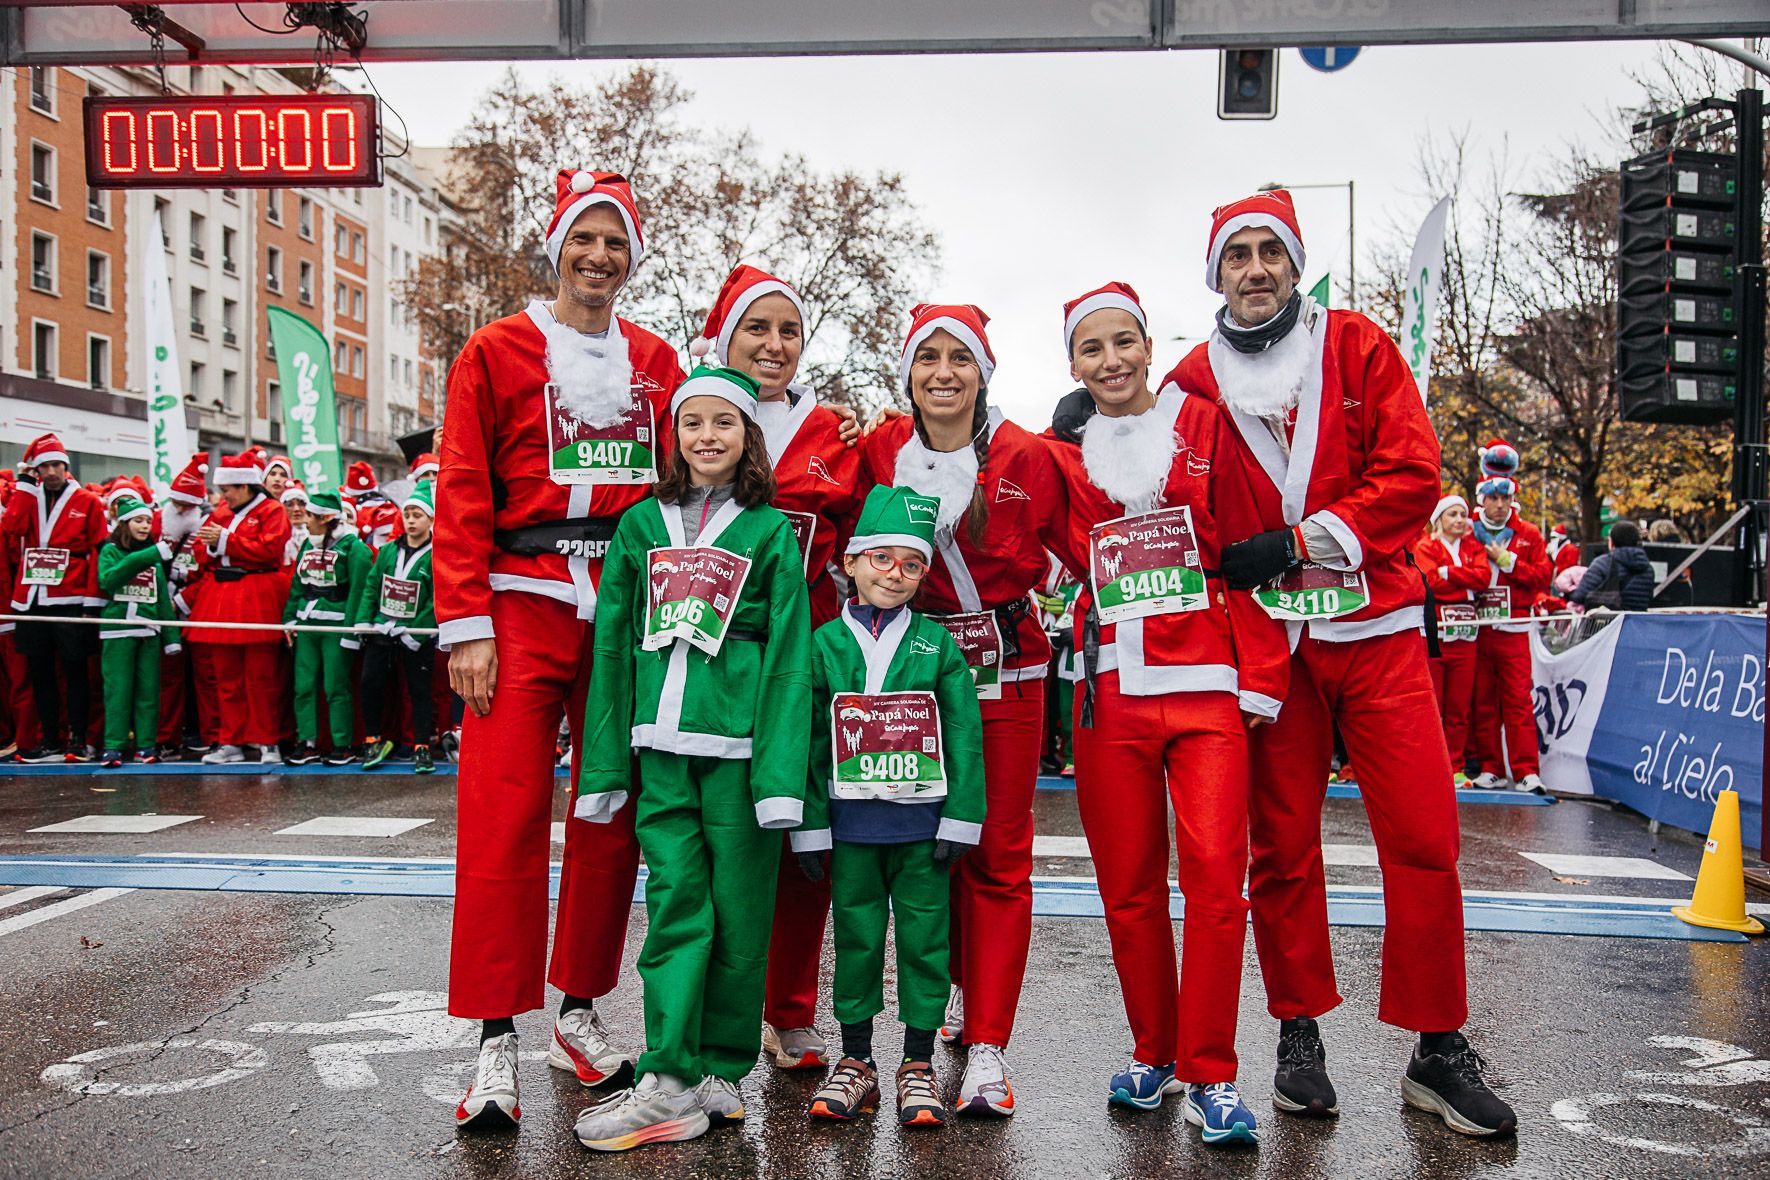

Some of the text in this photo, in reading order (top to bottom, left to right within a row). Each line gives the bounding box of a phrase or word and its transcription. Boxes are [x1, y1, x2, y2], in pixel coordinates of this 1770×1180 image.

[103, 109, 356, 172] 00:00:00
[577, 441, 633, 467] 9407
[1128, 525, 1191, 542] Papá Noe
[706, 560, 735, 582] Noel
[1120, 569, 1184, 602] 9404
[1657, 647, 1697, 708] De
[1695, 649, 1725, 713] la
[870, 707, 930, 724] Papá Noel
[860, 753, 919, 781] 9408
